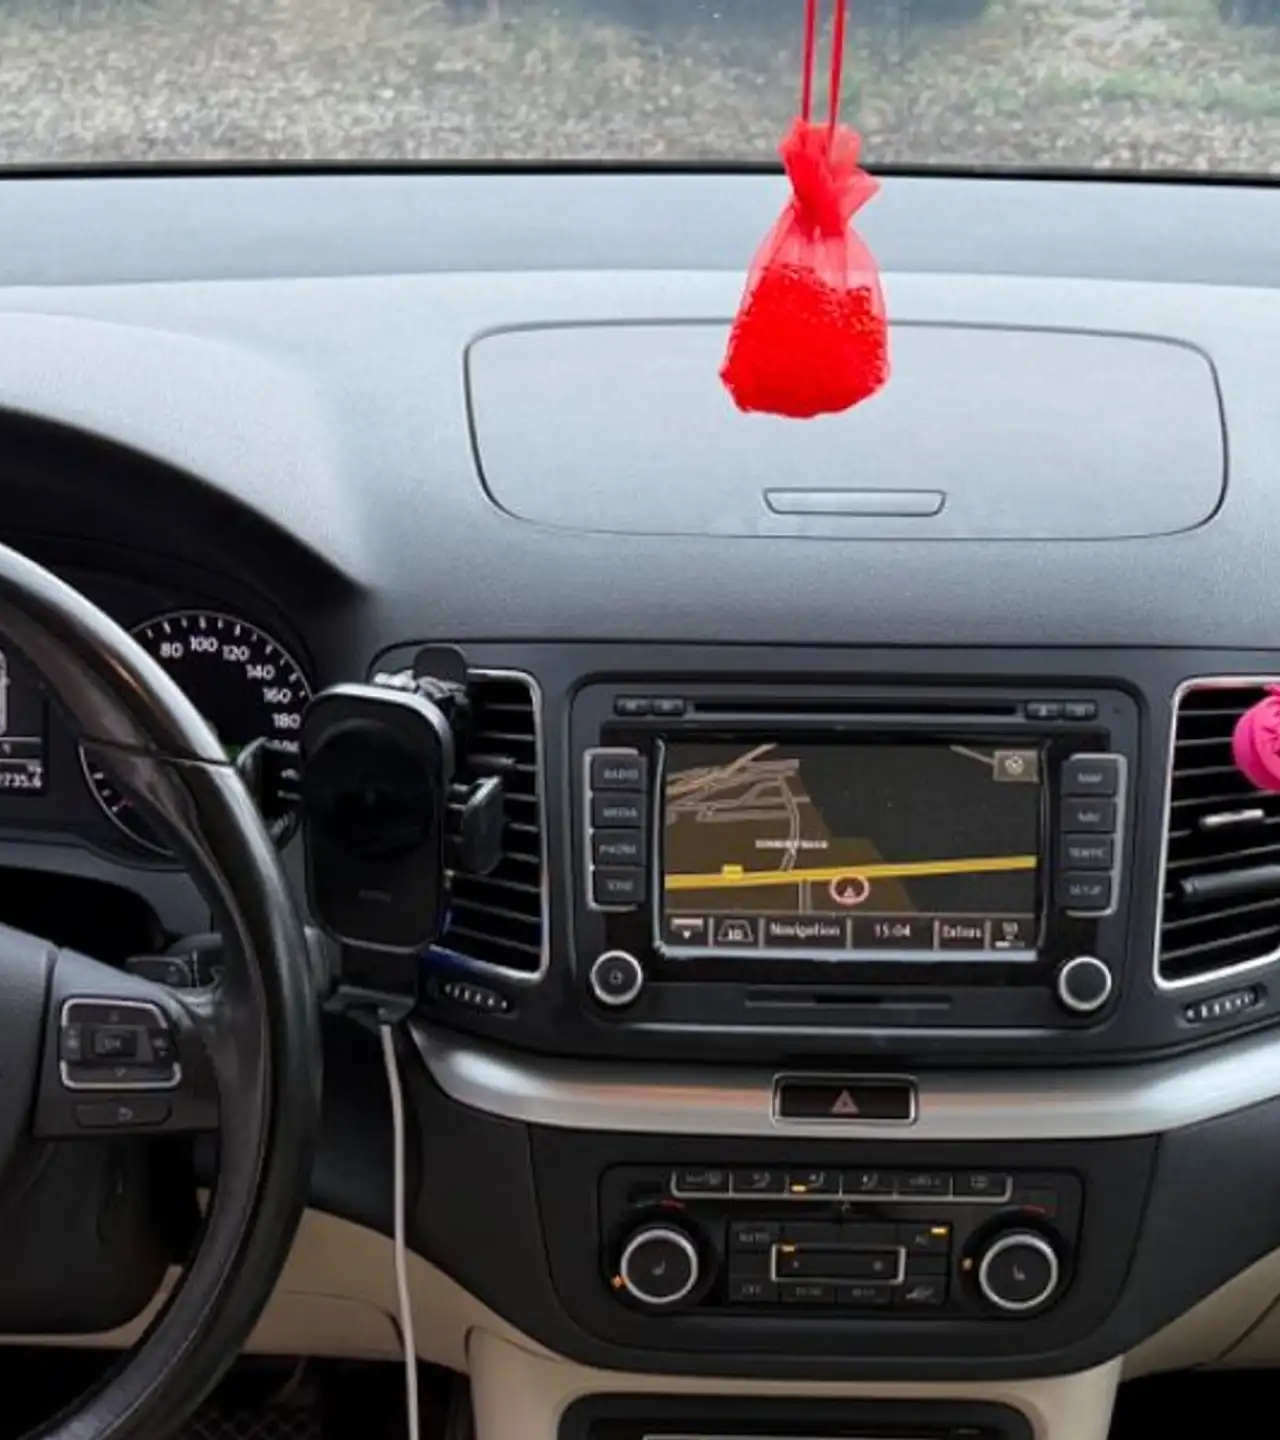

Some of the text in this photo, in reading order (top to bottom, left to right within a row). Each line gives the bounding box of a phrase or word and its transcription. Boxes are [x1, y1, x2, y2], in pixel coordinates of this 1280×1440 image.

[160, 643, 183, 659] 80
[189, 635, 219, 652] 100
[222, 645, 250, 662] 120
[246, 664, 276, 680] 140
[272, 713, 301, 729] 180
[770, 921, 841, 941] Navigation
[874, 922, 912, 939] 15:04
